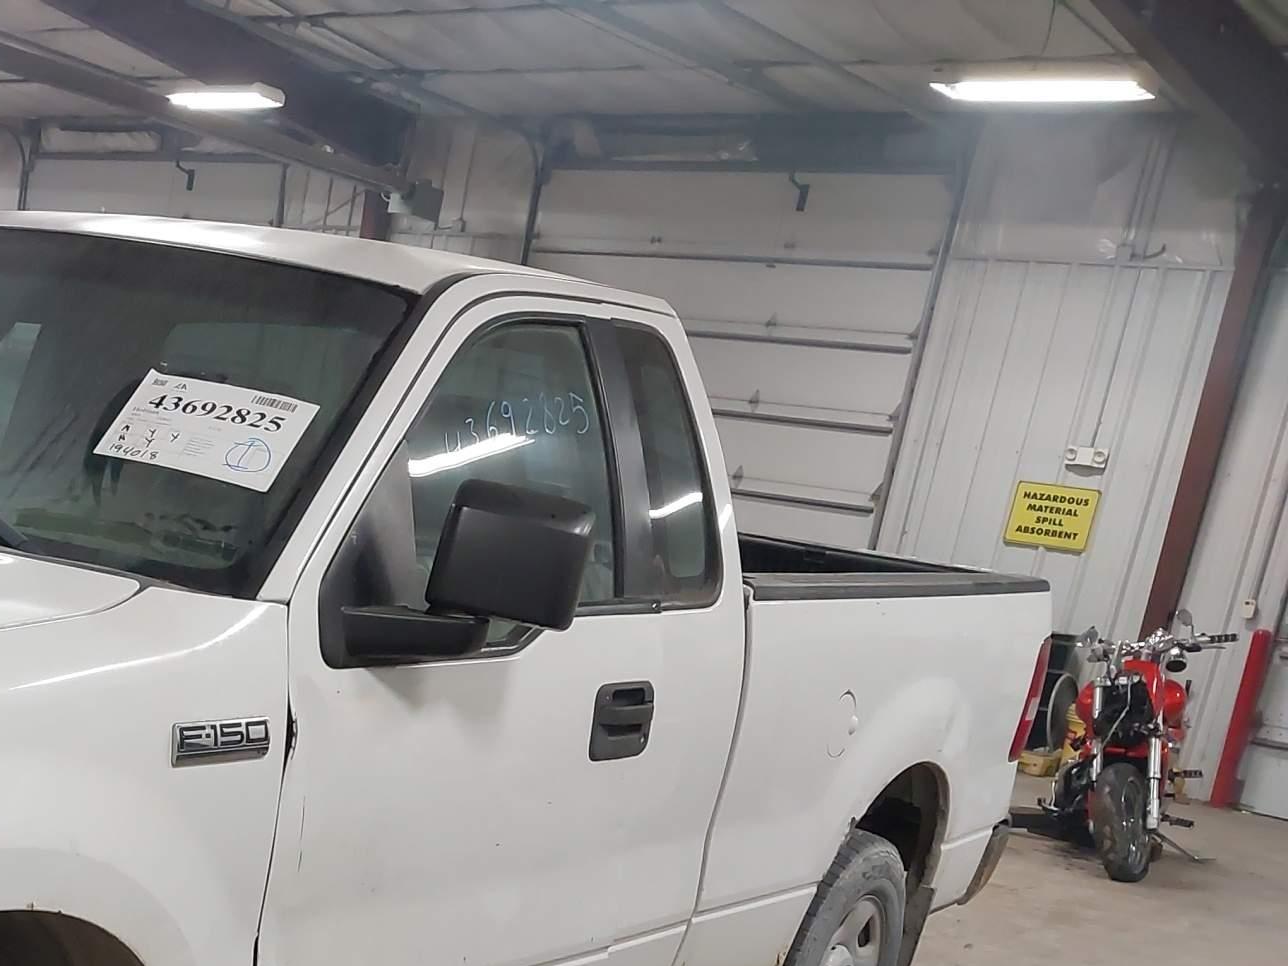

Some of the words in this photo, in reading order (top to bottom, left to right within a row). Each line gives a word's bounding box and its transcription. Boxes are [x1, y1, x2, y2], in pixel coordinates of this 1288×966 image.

[149, 394, 286, 432] 43692825
[1023, 491, 1090, 507] HAZARDOUS
[1026, 503, 1079, 517] MATERIAL
[1034, 516, 1064, 527] SPILL
[1016, 525, 1079, 540] ABSORBENT
